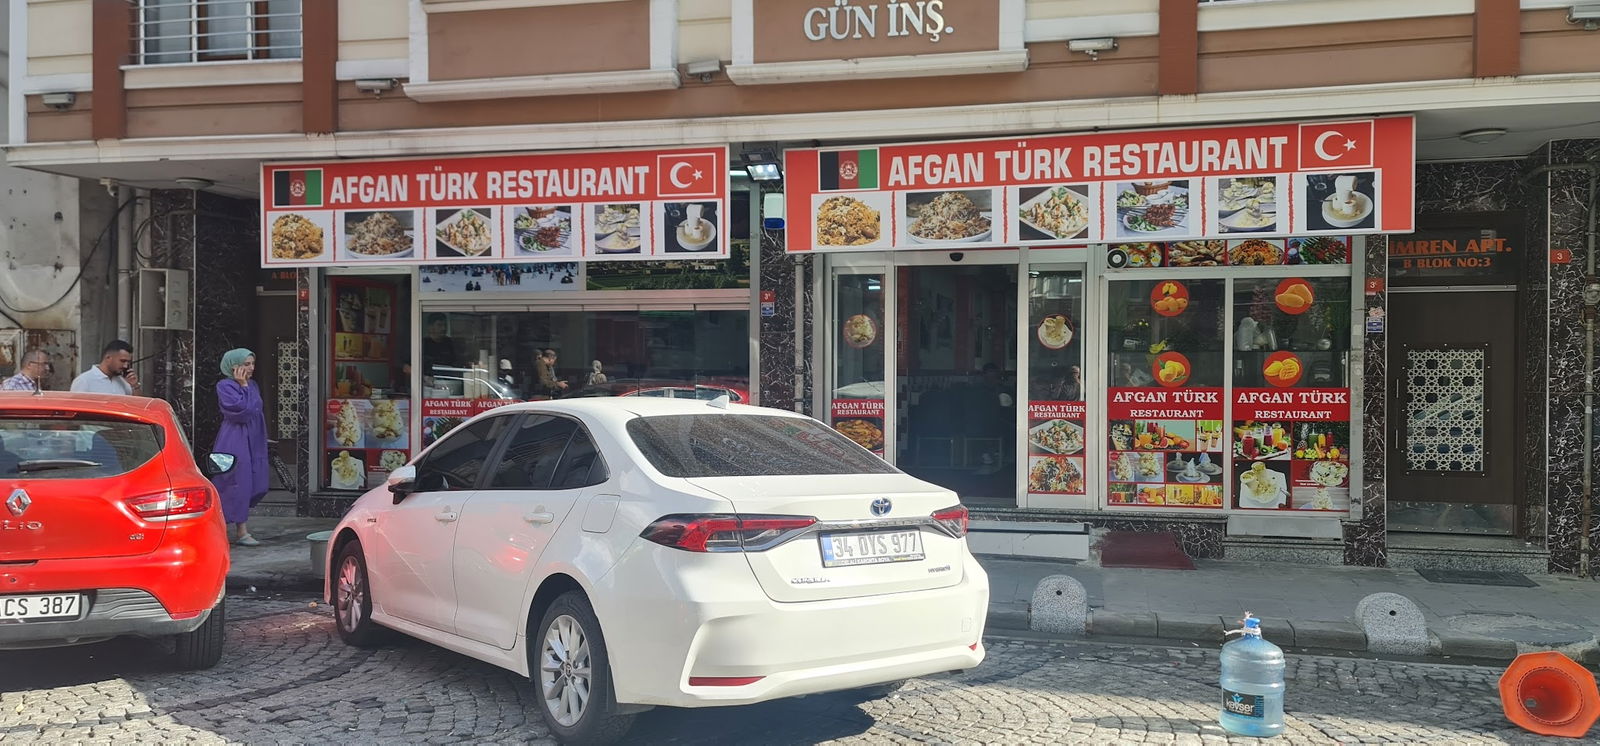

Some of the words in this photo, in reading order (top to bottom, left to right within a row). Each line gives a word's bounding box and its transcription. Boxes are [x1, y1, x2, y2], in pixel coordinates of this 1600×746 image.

[803, 0, 878, 41] GÜN
[887, 0, 954, 42] İNŞ.
[887, 152, 984, 186] AFGAN
[994, 141, 1072, 182] TÜRK
[1083, 136, 1288, 177] RESTAURANT
[329, 174, 408, 204] AFGAN
[416, 165, 479, 201] TÜRK
[486, 165, 649, 199] RESTAURANT
[1465, 238, 1513, 255] APT.
[1556, 252, 1563, 260] 3
[1417, 258, 1452, 268] BLOK
[1456, 257, 1492, 268] NO:3
[1113, 391, 1168, 403] AFGAN
[1172, 389, 1218, 403] TÜRK
[1237, 392, 1293, 404] AFGAN
[1298, 390, 1347, 404] TÜRK
[424, 400, 449, 408] AFGAN
[450, 399, 472, 408] TÜRK
[831, 402, 859, 410] AFGAN
[1028, 404, 1058, 412] AFGAN
[1060, 403, 1086, 413] TÜRK
[1034, 411, 1081, 419] RESTAURANT
[1130, 409, 1204, 418] RESTAURANT
[1254, 410, 1332, 419] RESTAURANT
[0, 519, 43, 531] LIO
[833, 535, 854, 558] 34
[858, 534, 888, 556] DYS
[891, 532, 916, 554] 977
[0, 598, 29, 617] CS
[39, 596, 76, 615] 387
